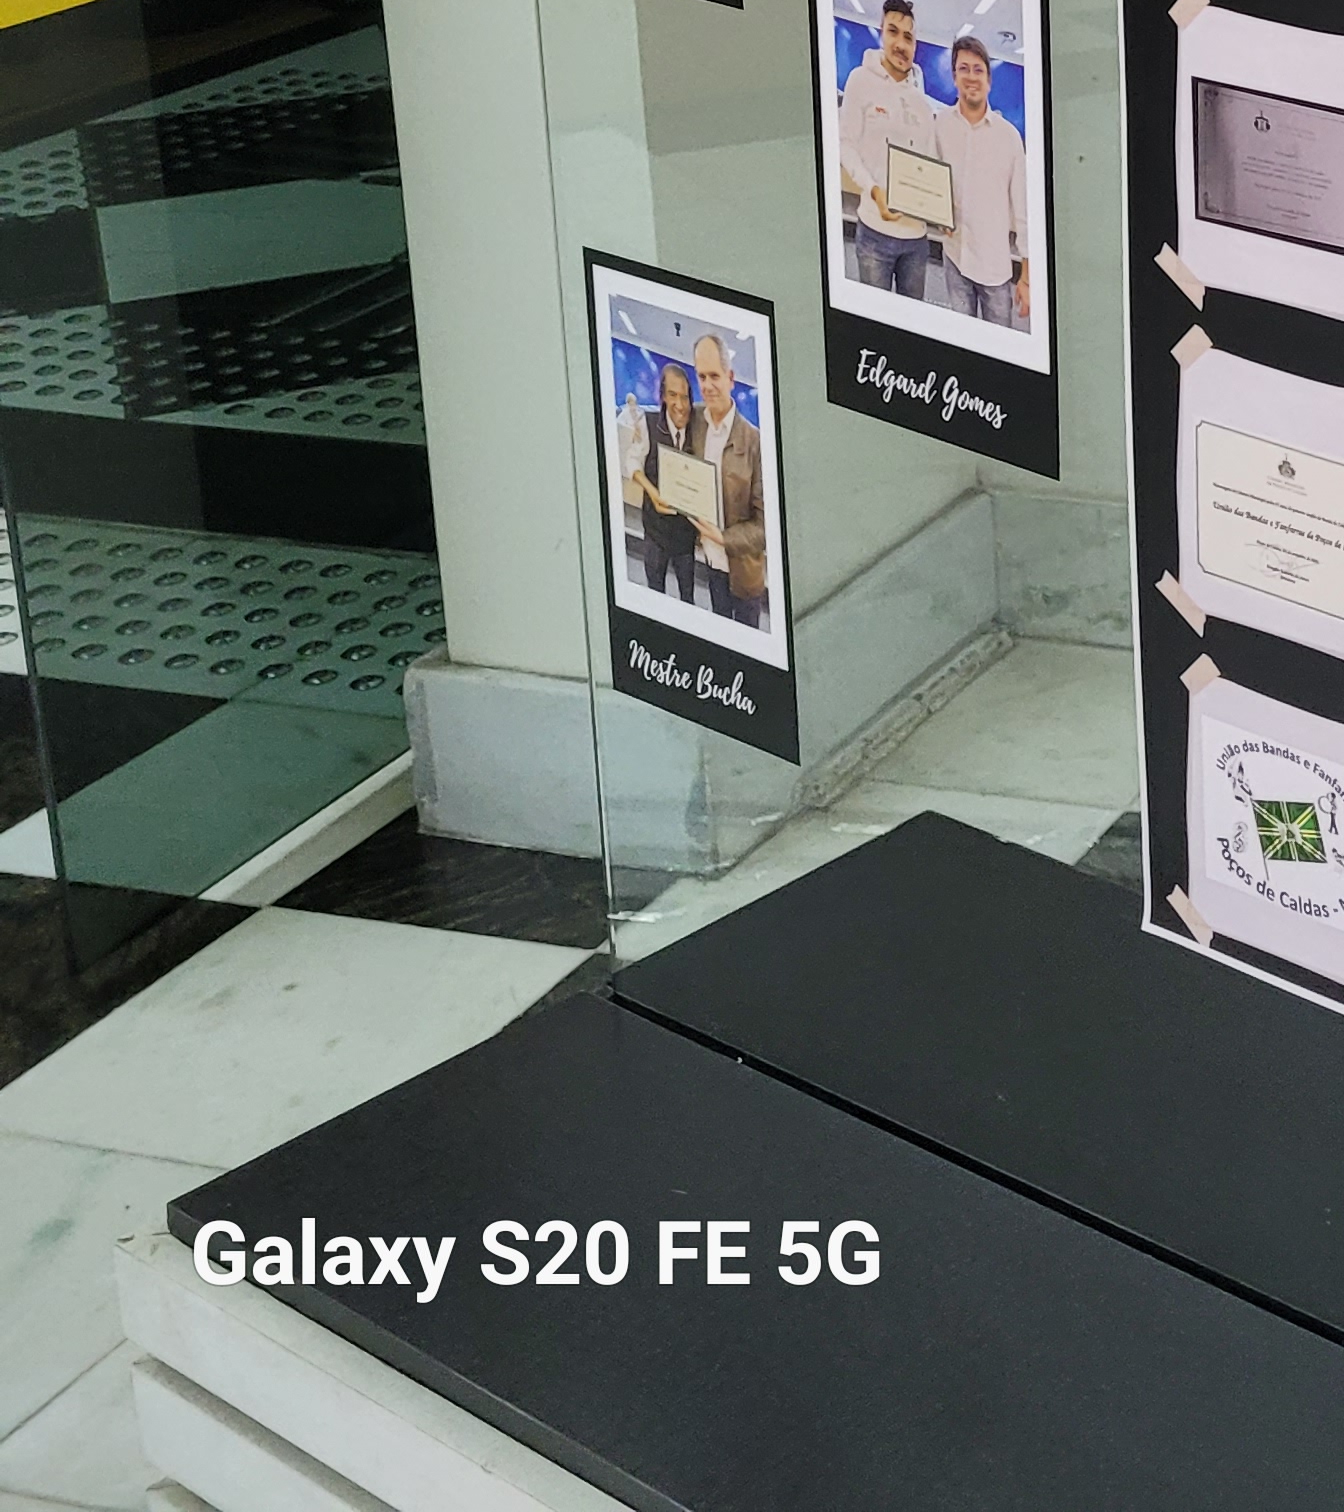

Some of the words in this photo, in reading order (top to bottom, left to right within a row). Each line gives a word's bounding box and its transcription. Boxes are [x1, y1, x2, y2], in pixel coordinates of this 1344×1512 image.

[856, 348, 937, 404] Edgard
[941, 376, 1007, 429] Gomes
[629, 639, 692, 689] Mestre
[696, 665, 757, 715] Bucha
[1216, 743, 1241, 771] União
[1242, 740, 1260, 753] das
[1262, 741, 1301, 764] Bandas
[1303, 760, 1310, 770] e
[1217, 837, 1252, 886] Poços
[1256, 880, 1275, 901] de
[1279, 891, 1330, 918] Caldas
